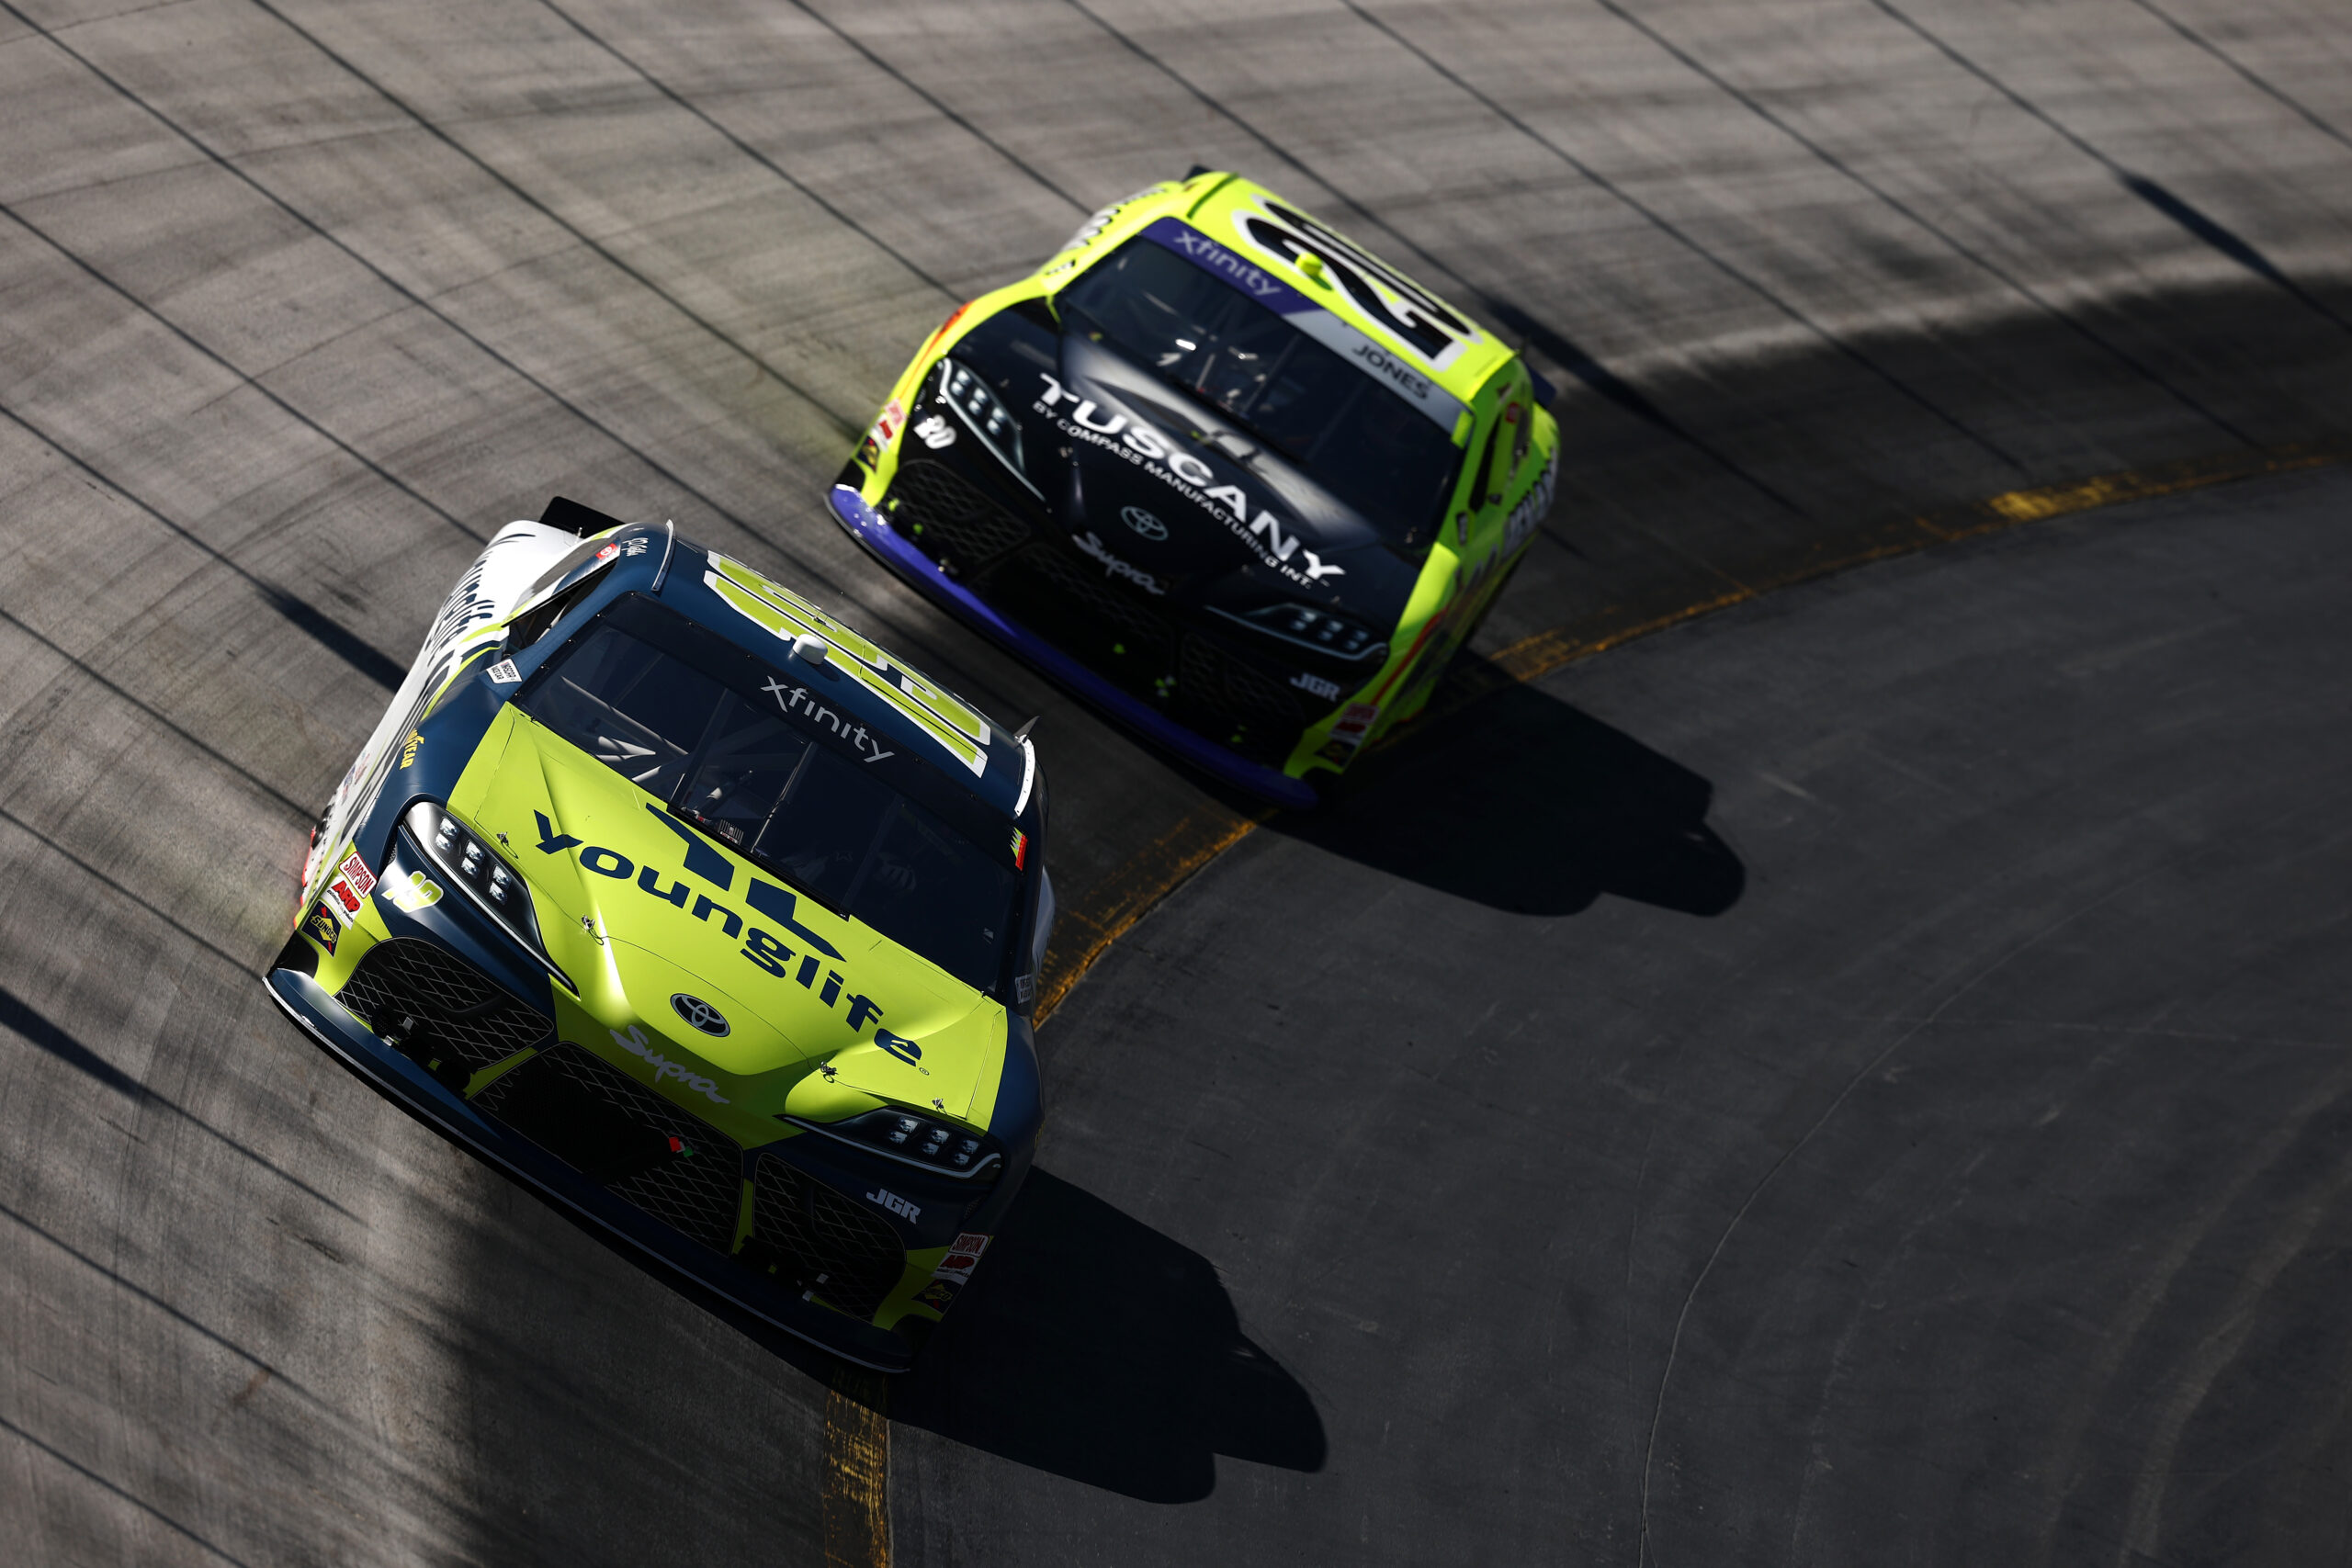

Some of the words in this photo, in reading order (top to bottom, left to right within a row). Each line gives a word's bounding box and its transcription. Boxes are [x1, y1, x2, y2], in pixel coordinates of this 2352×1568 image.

[1173, 230, 1283, 297] xfinity
[1352, 344, 1428, 400] JONES
[1033, 400, 1057, 419] BY
[1057, 418, 1144, 466] COMPASS
[1144, 461, 1280, 568] MANUFACTURING
[1039, 372, 1346, 581] TUSCANY
[1071, 531, 1165, 594] Supra
[1289, 673, 1340, 702] JGR
[760, 675, 895, 762] xfinity
[332, 880, 360, 912] ARP
[344, 856, 374, 895] SIMPSON
[311, 916, 337, 943] SUNOCO
[533, 809, 922, 1066] younglife
[609, 1025, 729, 1103] Supra
[866, 1188, 921, 1224] JGR
[952, 1235, 985, 1255] SIMPSON
